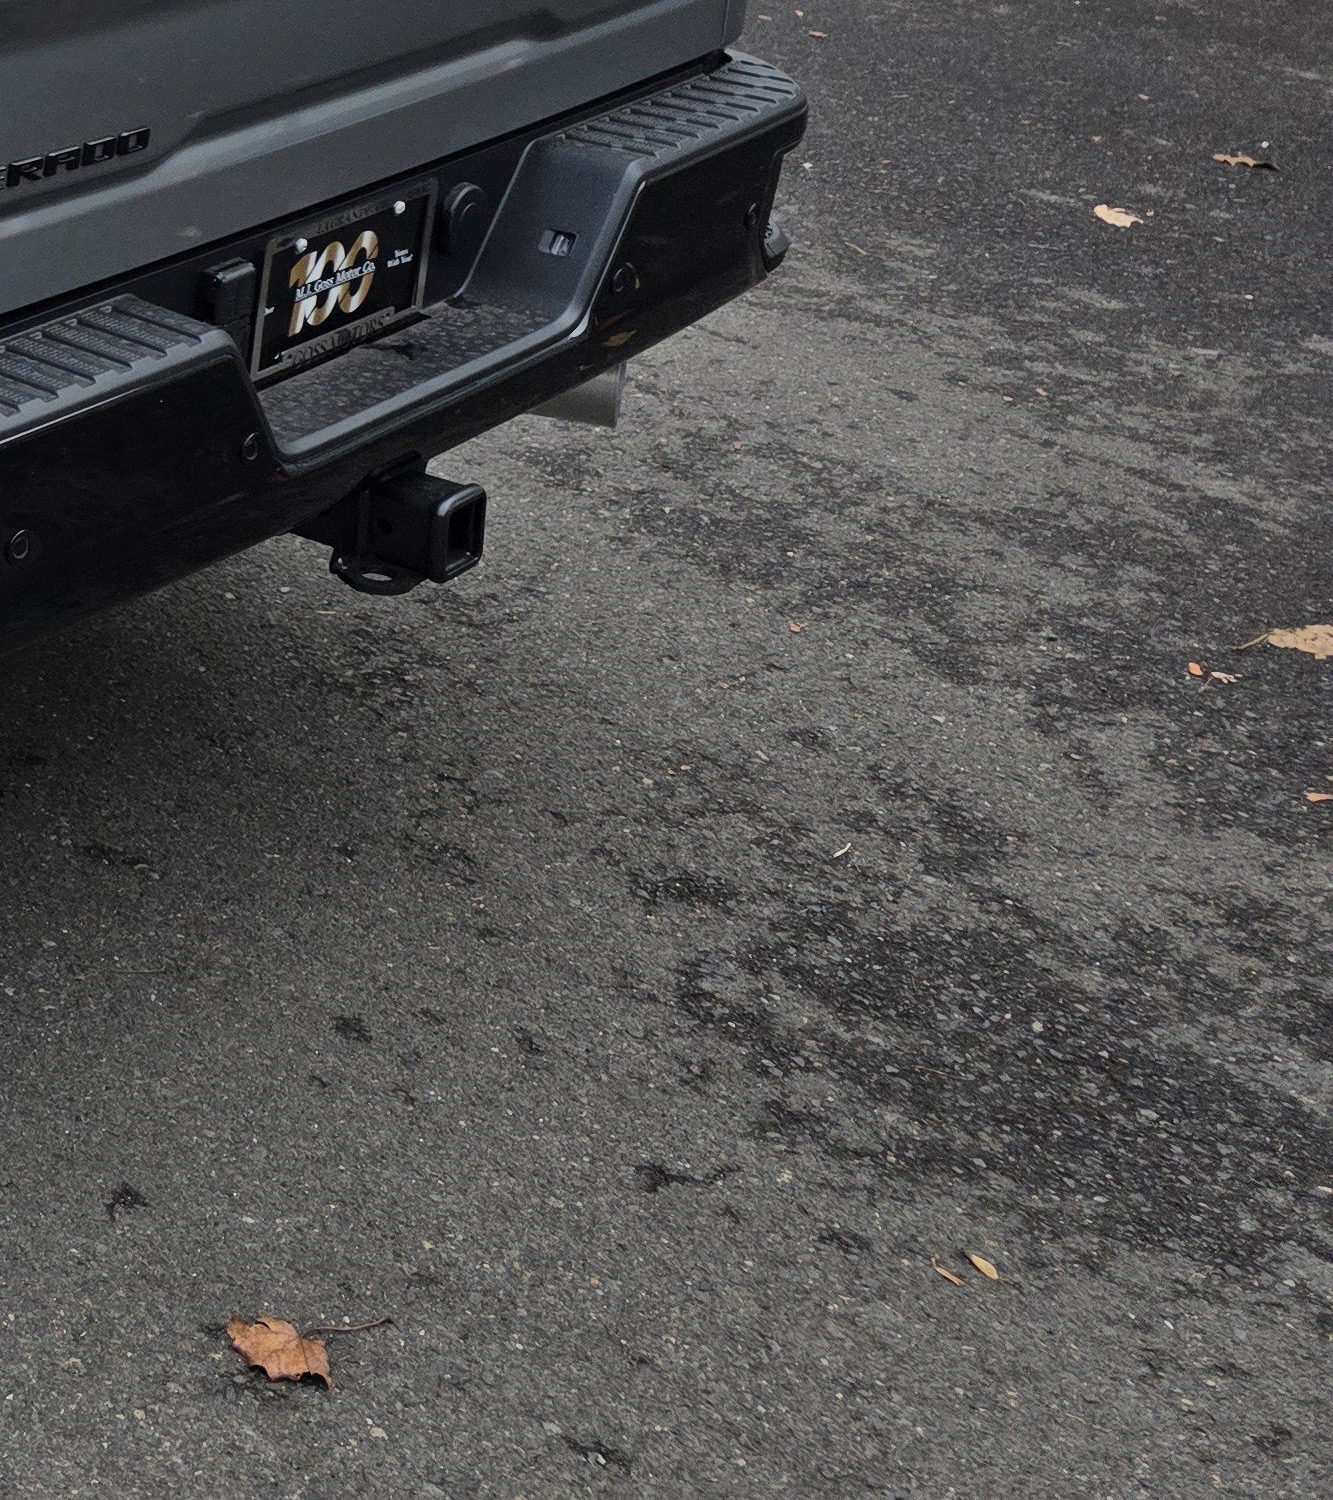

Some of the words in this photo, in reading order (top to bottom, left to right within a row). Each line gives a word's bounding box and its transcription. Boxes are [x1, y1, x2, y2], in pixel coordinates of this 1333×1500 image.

[288, 230, 379, 338] 100
[314, 277, 334, 293] Goss
[362, 261, 376, 274] Co.
